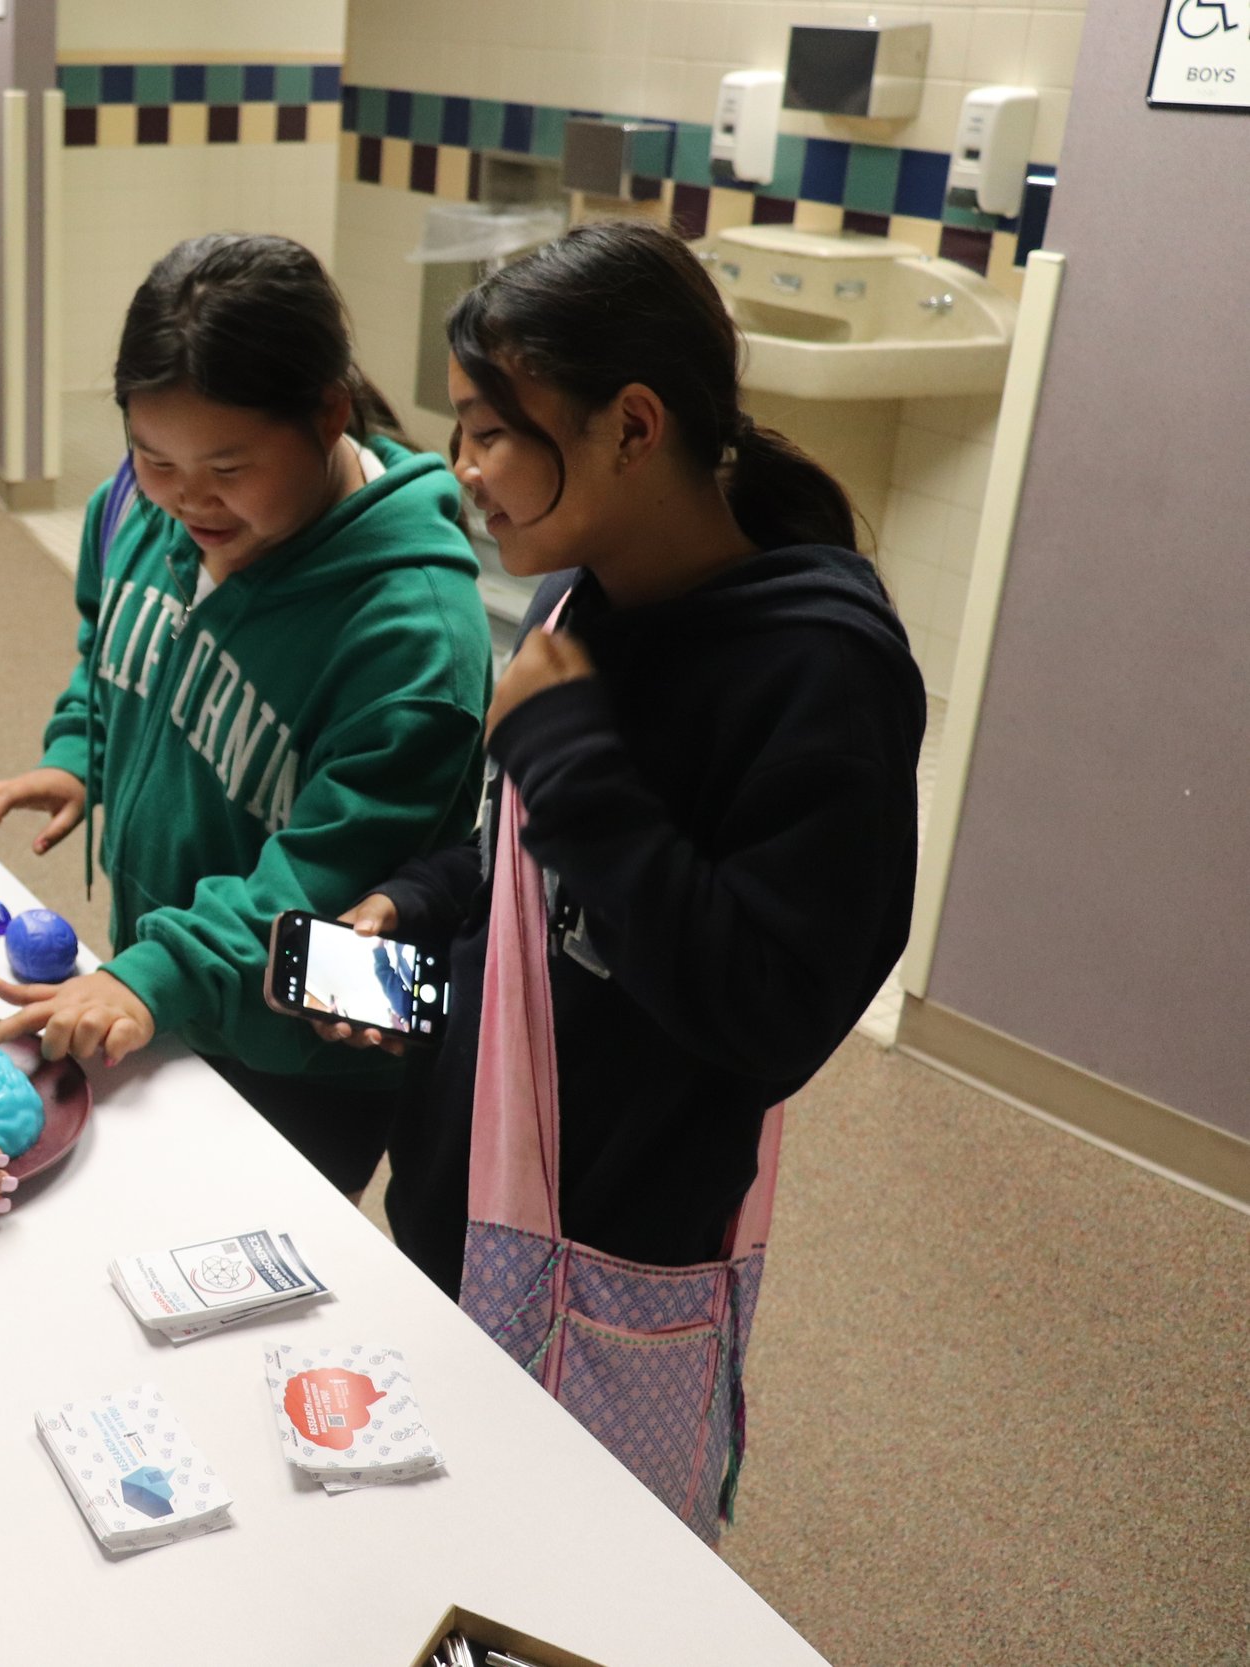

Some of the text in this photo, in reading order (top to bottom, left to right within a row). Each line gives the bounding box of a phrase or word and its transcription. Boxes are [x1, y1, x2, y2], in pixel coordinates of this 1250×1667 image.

[1186, 66, 1236, 83] BOYS
[246, 1234, 292, 1289] NEUROSCIENCE
[150, 1290, 174, 1313] RESEARCH
[303, 1403, 319, 1435] RESEARCH
[102, 1437, 130, 1472] RESEARCH
